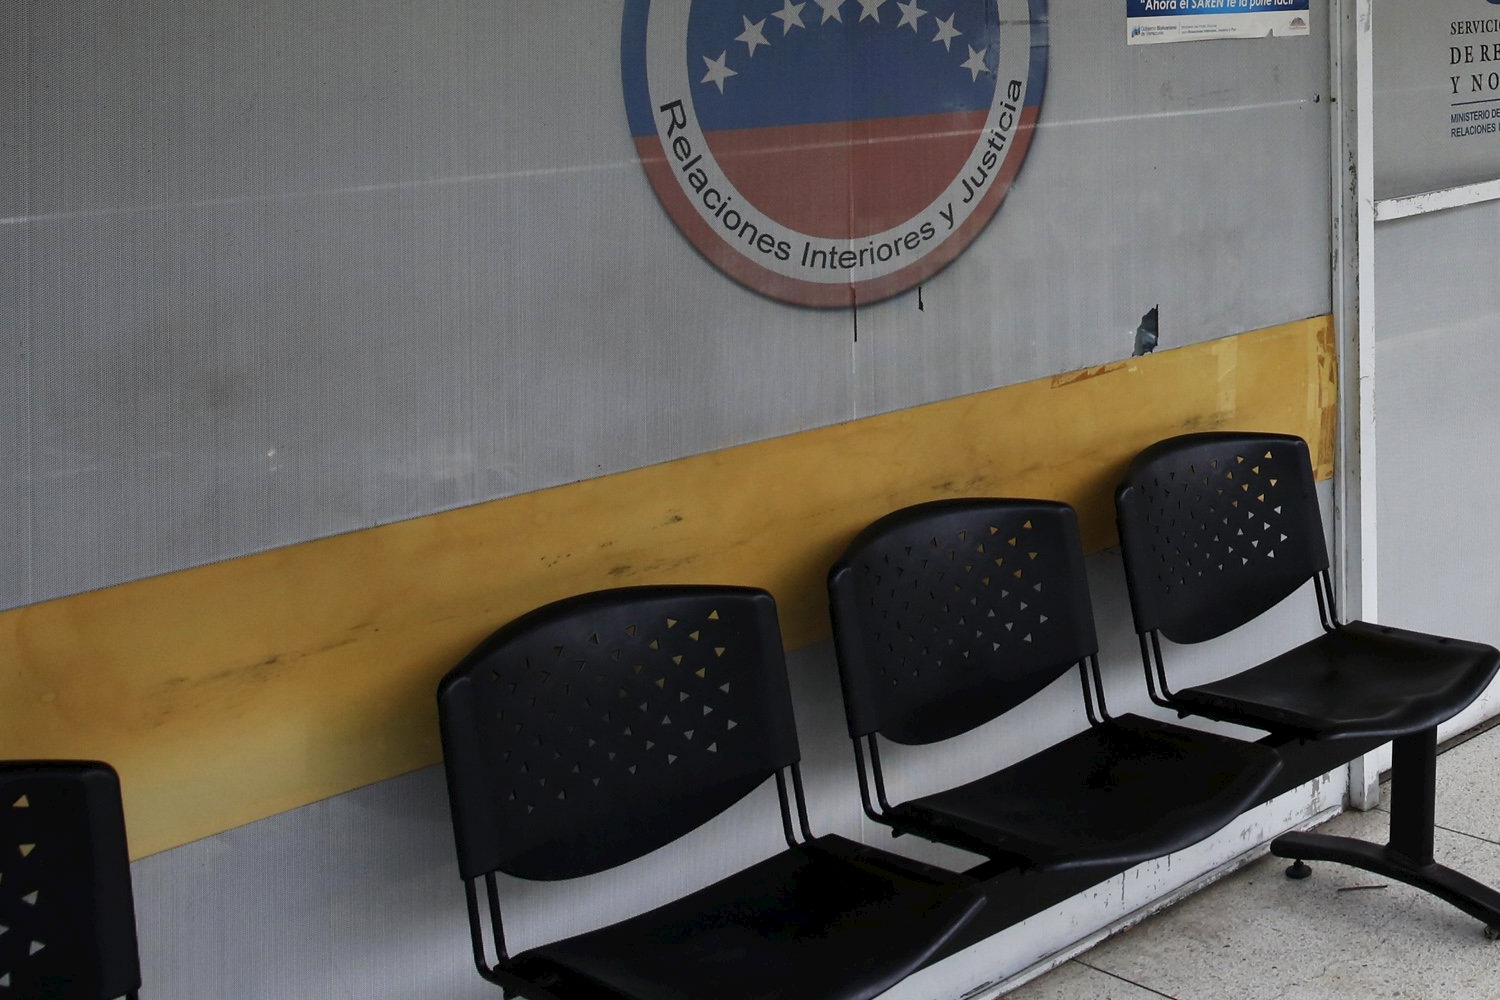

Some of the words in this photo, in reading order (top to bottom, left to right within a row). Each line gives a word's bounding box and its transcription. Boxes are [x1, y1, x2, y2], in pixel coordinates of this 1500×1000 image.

[1450, 45, 1474, 65] DE
[1450, 76, 1460, 94] Y
[1451, 109, 1490, 123] MINISTERIO
[1451, 123, 1496, 138] RELACIONES
[660, 98, 791, 262] Relaciones
[801, 219, 935, 270] Interiores
[940, 203, 955, 229] y
[961, 78, 1023, 205] Justicia
